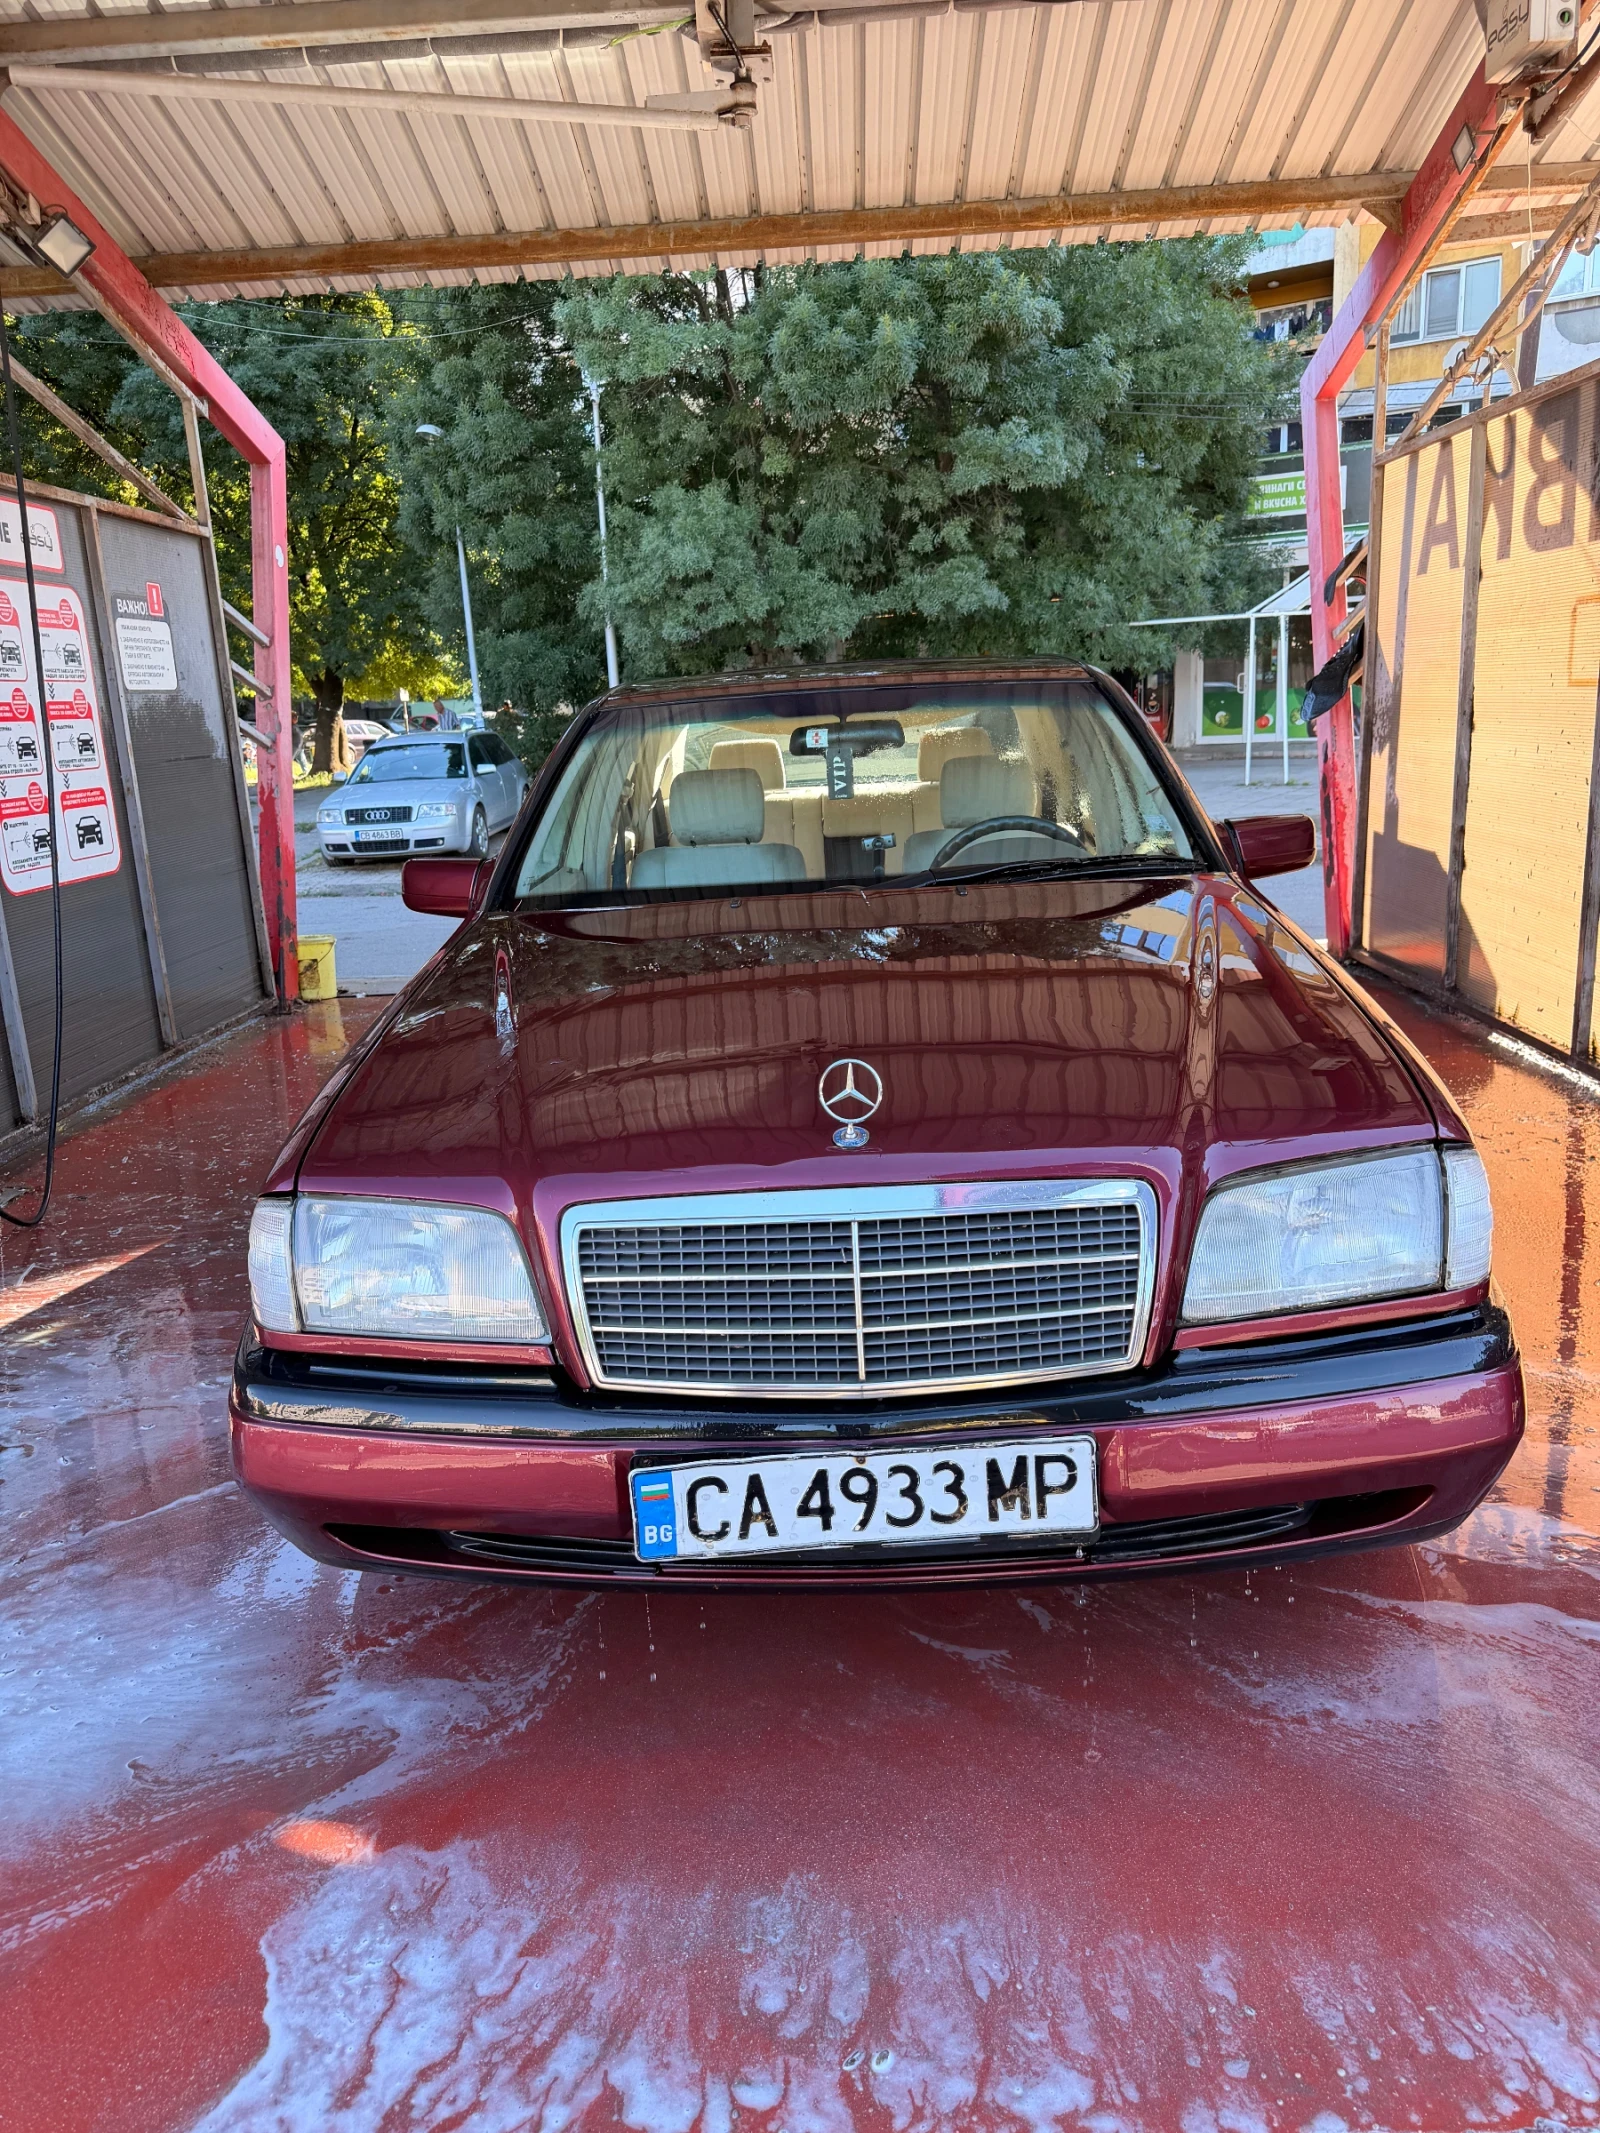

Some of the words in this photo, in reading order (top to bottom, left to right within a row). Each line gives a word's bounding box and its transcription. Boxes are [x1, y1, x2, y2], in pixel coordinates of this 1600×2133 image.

[1488, 0, 1529, 53] easy
[1263, 496, 1297, 509] ВКУСНА
[116, 598, 148, 615] ВАЖНО!
[833, 756, 846, 792] VIP
[686, 1473, 780, 1542] CA
[796, 1460, 969, 1532] 4933
[986, 1453, 1078, 1522] MP
[644, 1524, 674, 1544] BG
